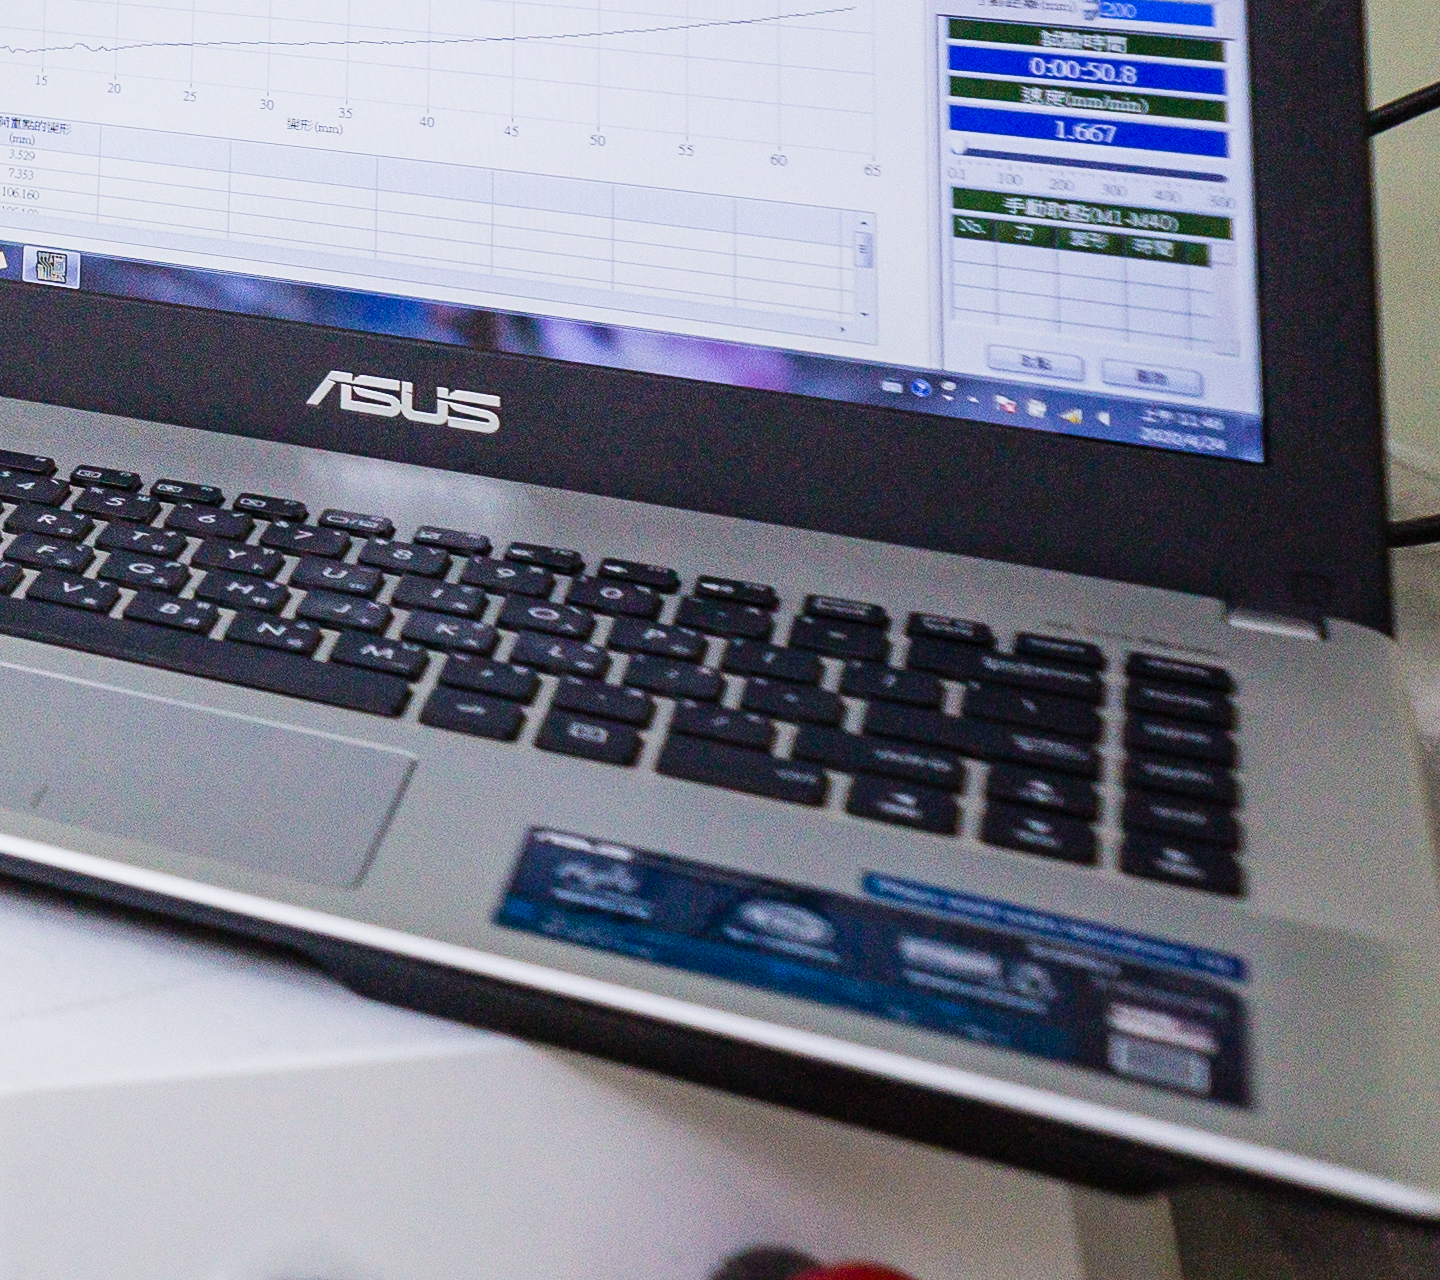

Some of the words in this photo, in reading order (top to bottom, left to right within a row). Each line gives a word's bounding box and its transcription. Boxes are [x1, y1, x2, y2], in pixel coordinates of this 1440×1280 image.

[35, 75, 48, 87] 15
[107, 83, 122, 95] 20
[183, 90, 198, 103] 25
[260, 98, 275, 111] 30
[339, 107, 354, 120] 35
[420, 116, 435, 129] 40
[504, 125, 520, 138] 45
[589, 134, 606, 147] 50
[678, 143, 695, 157] 55
[770, 153, 789, 167] 60
[864, 163, 883, 177] 65
[1054, 120, 1118, 143] 1.667
[9, 133, 36, 146] (mm)
[9, 149, 36, 161] 3.529
[8, 167, 34, 180] 7.353
[2, 186, 39, 200] 106.160
[306, 370, 501, 434] ASUS
[17, 481, 36, 490] 4
[105, 497, 126, 507] 5
[36, 514, 57, 525] R
[197, 514, 216, 524] 6
[132, 530, 150, 541] T
[294, 530, 313, 540] 7
[36, 545, 58, 554] F
[229, 549, 247, 559] Y
[128, 562, 156, 574] G
[322, 567, 348, 579] U
[62, 582, 84, 593] V
[227, 582, 254, 594] H
[257, 622, 287, 636] N
[359, 644, 393, 660] M
